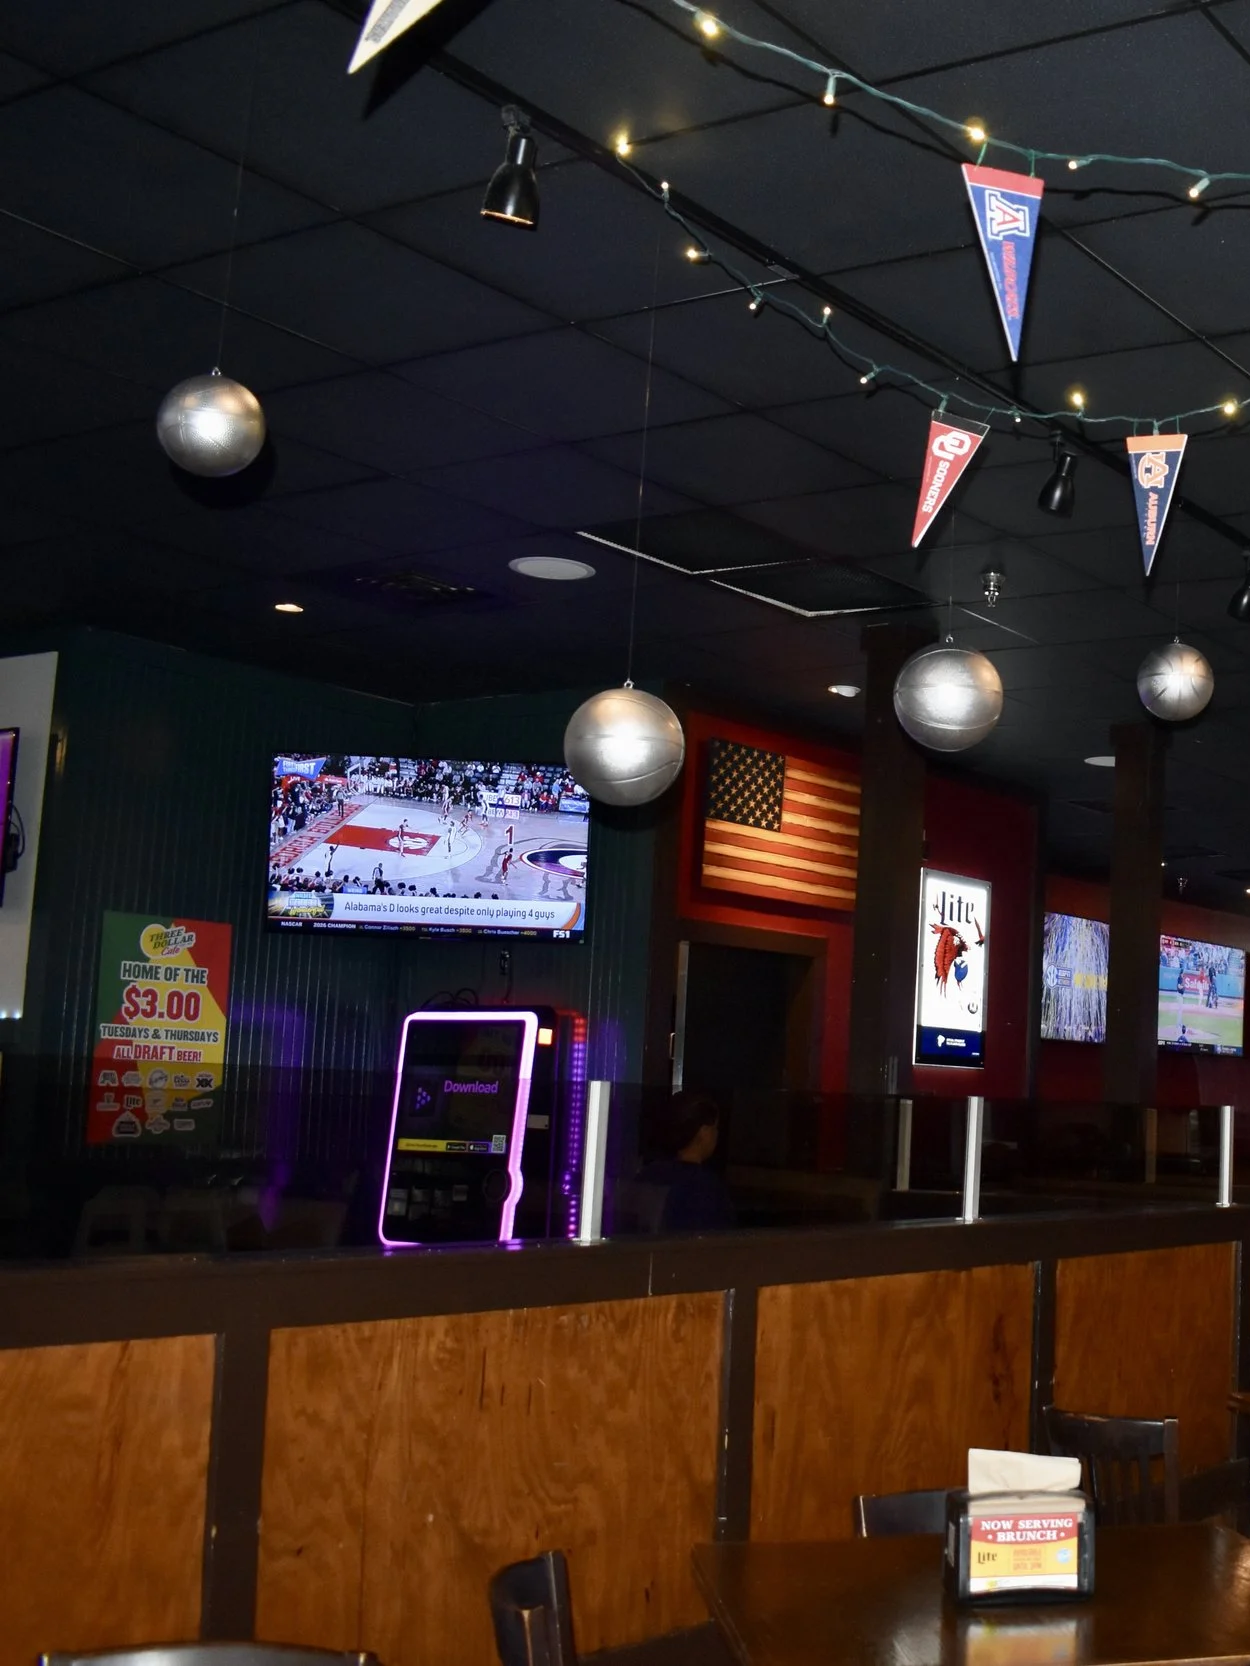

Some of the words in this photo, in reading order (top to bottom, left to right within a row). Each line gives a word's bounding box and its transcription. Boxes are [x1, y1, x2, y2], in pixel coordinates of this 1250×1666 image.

[984, 190, 1030, 240] A
[922, 460, 950, 513] SOONERS
[504, 795, 520, 804] 613
[505, 825, 515, 845] 1
[345, 902, 388, 912] Alabama's
[389, 903, 395, 912] D
[396, 904, 419, 913] looks
[421, 906, 443, 915] great
[444, 906, 475, 919] despite
[476, 907, 494, 918] only
[496, 907, 527, 919] playing
[534, 910, 555, 920] guys
[940, 891, 975, 926] Lite
[150, 928, 184, 942] THREE
[152, 934, 194, 949] DOLLAR
[553, 929, 570, 938] FS1
[122, 962, 160, 980] HOME
[164, 966, 181, 982] OF
[183, 968, 207, 984] THE
[124, 984, 201, 1021] $3.00
[101, 1025, 149, 1039] TUESDAYS
[151, 1028, 161, 1040] &
[164, 1028, 219, 1043] THURSDAYS
[115, 1046, 132, 1059] ALL
[134, 1044, 175, 1060] DRAFT
[176, 1050, 202, 1062] BEER!
[444, 1079, 499, 1094] Download
[980, 1519, 1013, 1531] NOW
[1018, 1518, 1073, 1530] SERVING
[996, 1530, 1057, 1543] BRUNCH
[977, 1551, 998, 1565] Lite
